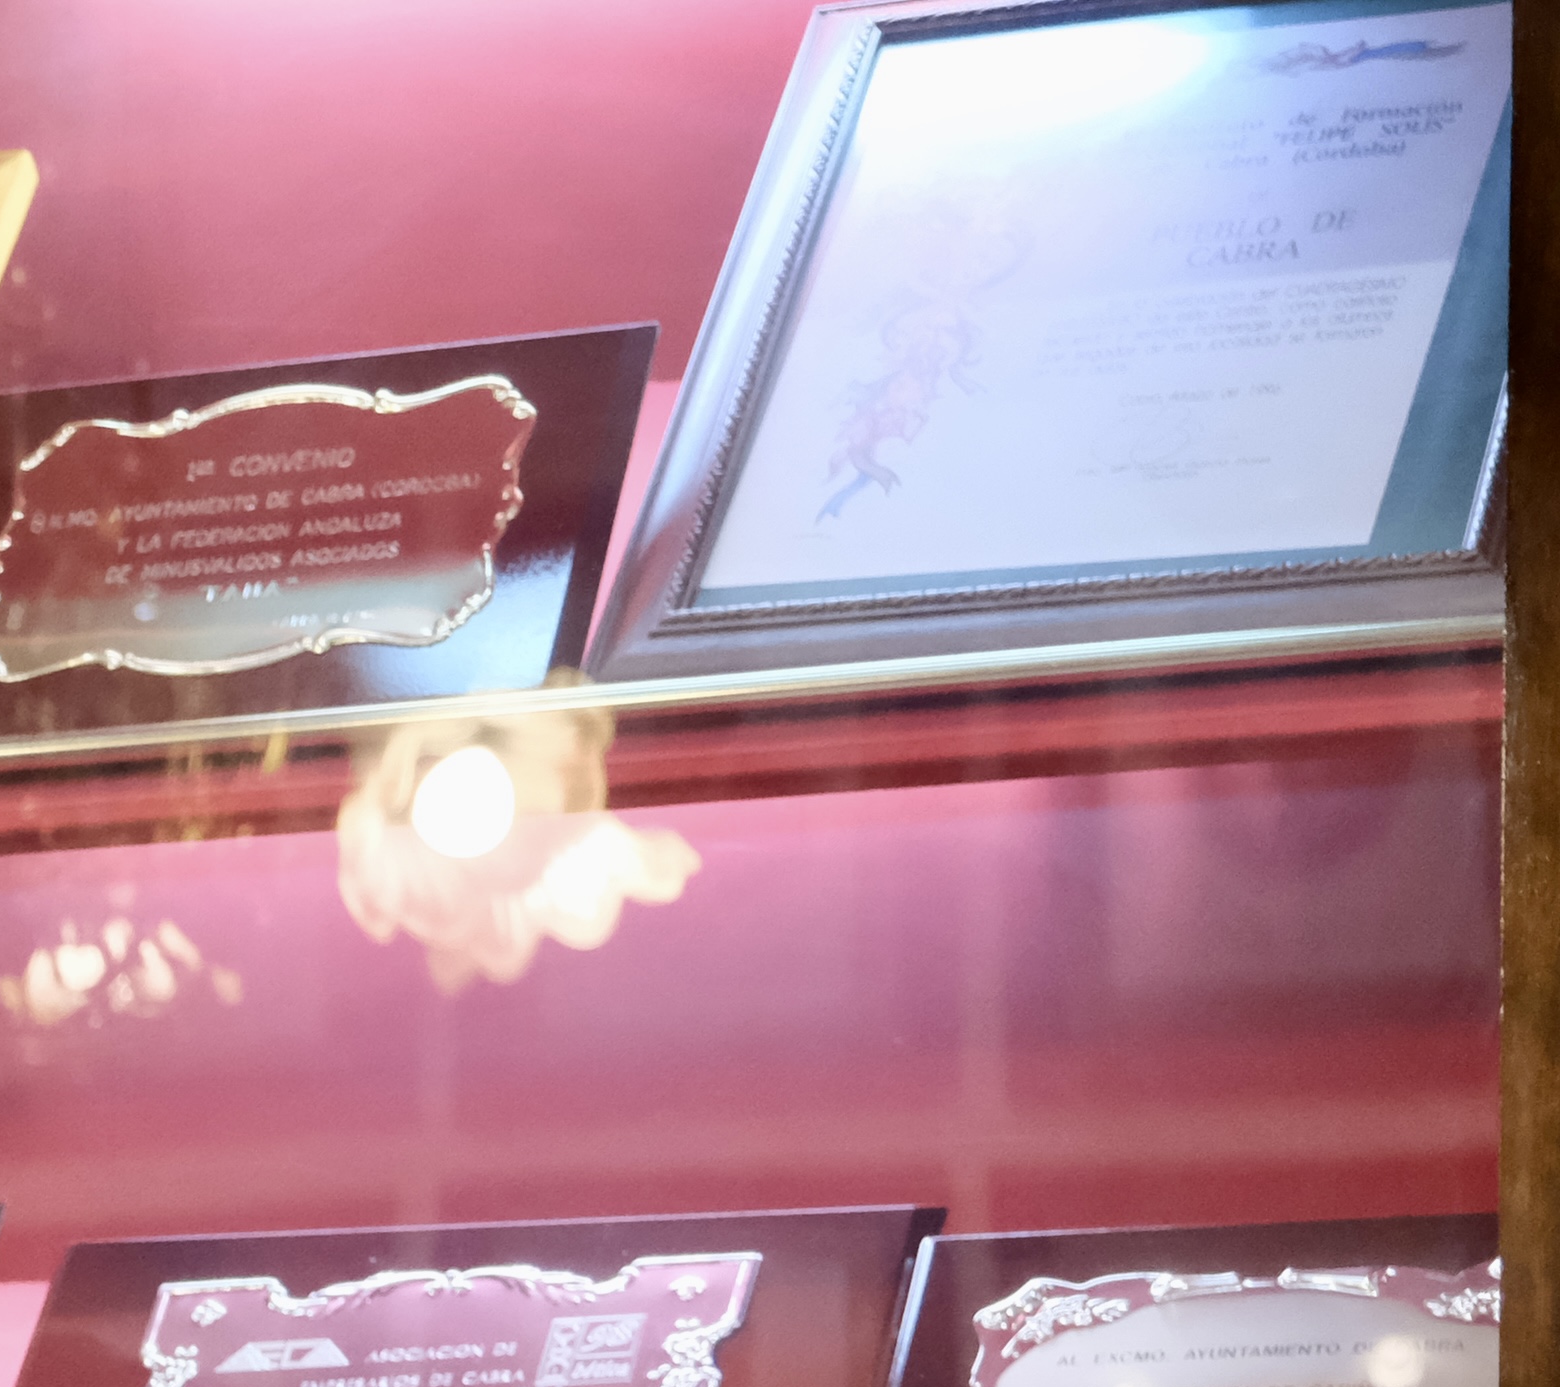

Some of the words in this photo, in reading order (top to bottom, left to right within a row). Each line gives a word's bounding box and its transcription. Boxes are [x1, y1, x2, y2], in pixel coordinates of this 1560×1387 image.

[1310, 209, 1358, 234] DE
[1185, 238, 1300, 266] CABRA
[228, 446, 357, 477] CONVENIO
[265, 489, 292, 510] DE
[135, 533, 162, 553] LA
[169, 521, 291, 549] FEDERACION
[298, 511, 402, 537] ANDALUZA
[289, 540, 401, 567] ASOCIADOS
[365, 1343, 485, 1364] ASOCIACION
[1183, 1340, 1342, 1362] AYUNTAMIENTO
